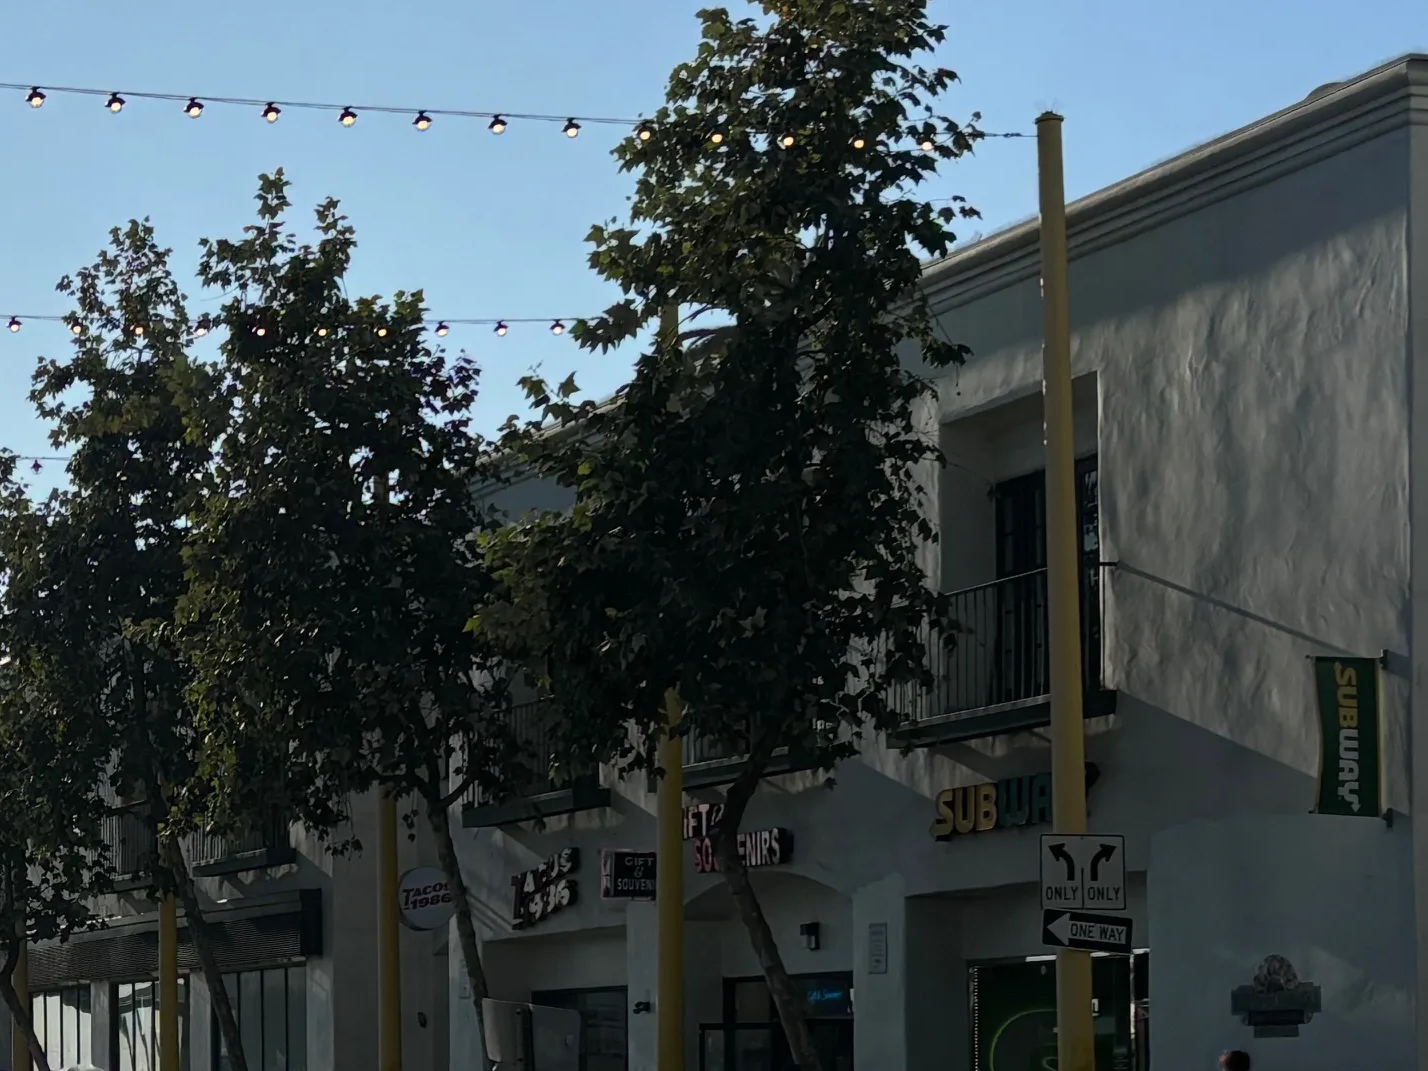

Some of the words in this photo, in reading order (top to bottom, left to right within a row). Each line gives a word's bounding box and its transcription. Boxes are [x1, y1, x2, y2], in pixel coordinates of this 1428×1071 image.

[1333, 661, 1362, 813] SUBWAY
[929, 772, 1054, 840] SUBWA
[683, 803, 710, 839] IFT
[693, 827, 781, 872] SOENIRS
[624, 856, 655, 867] GIFT
[616, 878, 655, 891] SOUVENI
[1045, 886, 1078, 901] ONLY
[1087, 886, 1121, 901] ONLY
[410, 893, 452, 910] 1986
[1070, 923, 1095, 938] ONE
[1099, 926, 1125, 942] WAY
